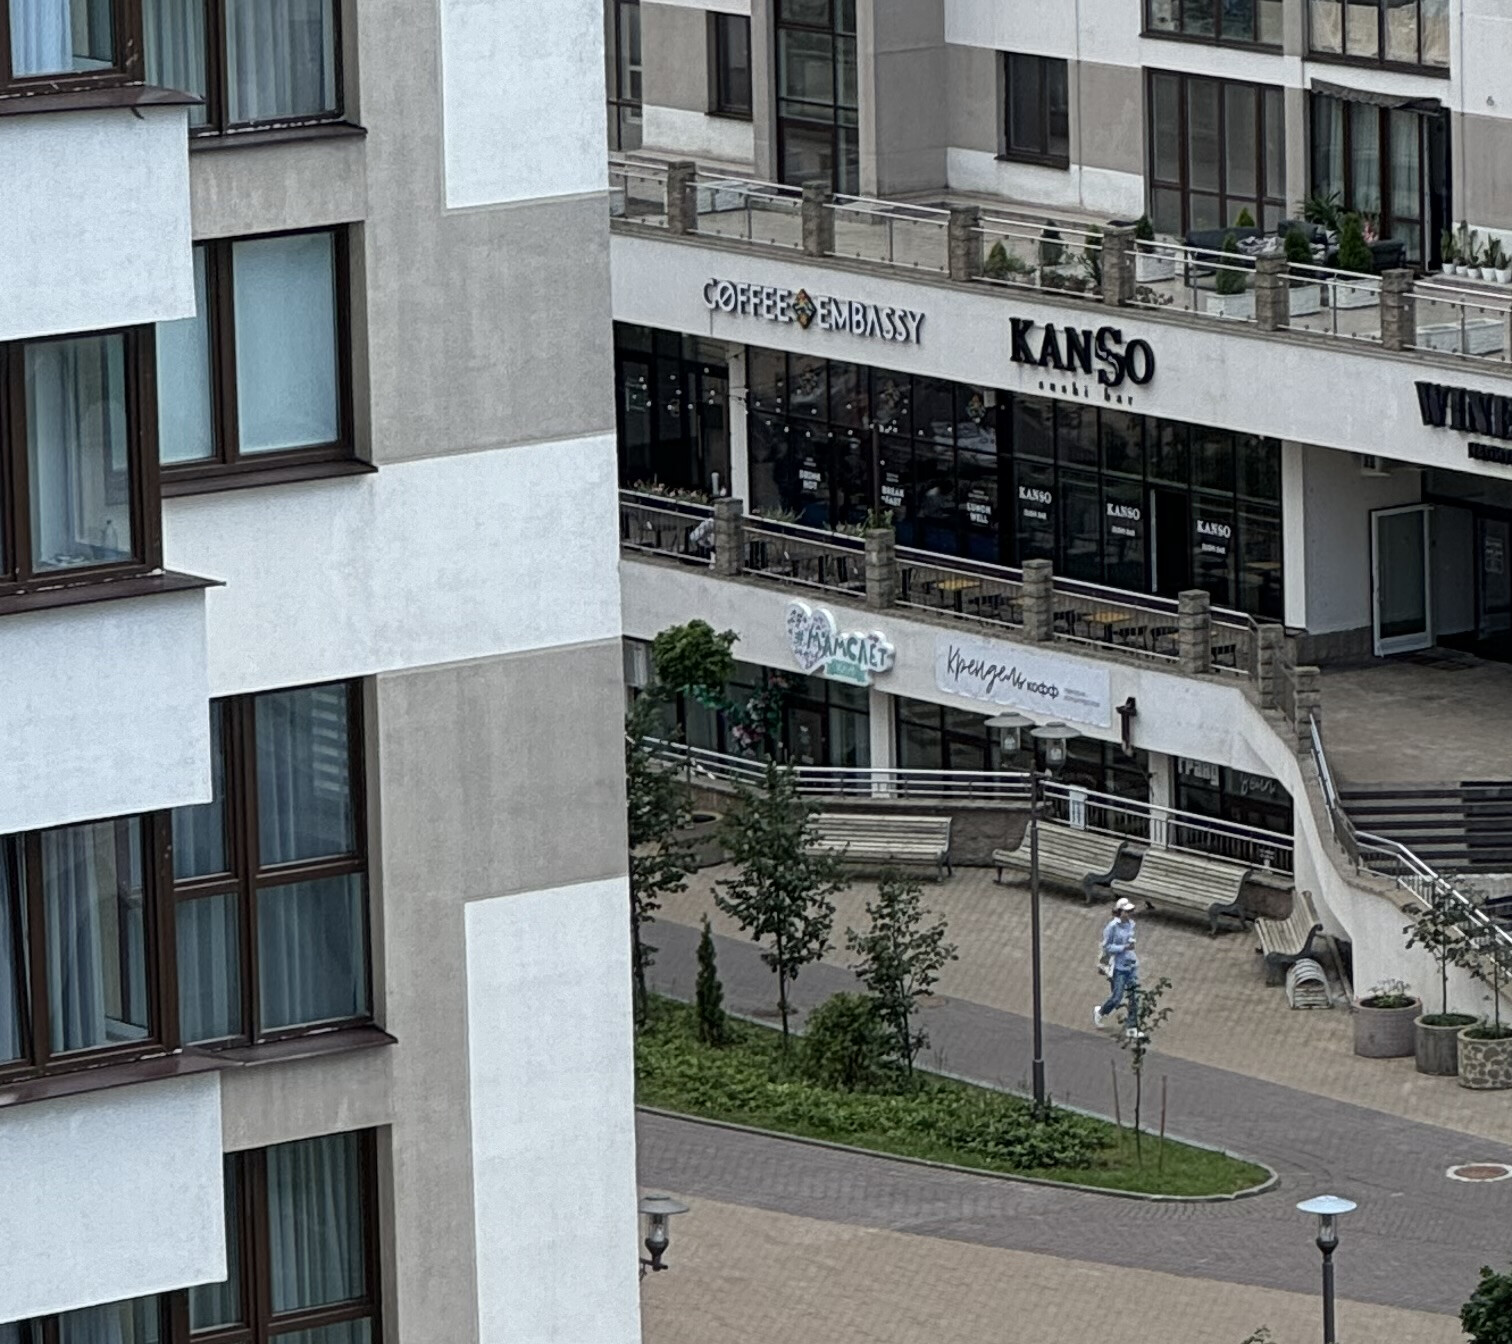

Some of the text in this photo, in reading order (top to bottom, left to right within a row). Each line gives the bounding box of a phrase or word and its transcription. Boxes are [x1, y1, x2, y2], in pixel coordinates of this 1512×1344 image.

[817, 295, 925, 344] EMBASSY
[1009, 317, 1155, 387] KANSO
[1104, 387, 1133, 405] bar
[1019, 486, 1051, 504] KANSO
[1107, 503, 1140, 520] KANSO
[1197, 520, 1231, 538] KANSO
[947, 645, 1027, 694] Крендель
